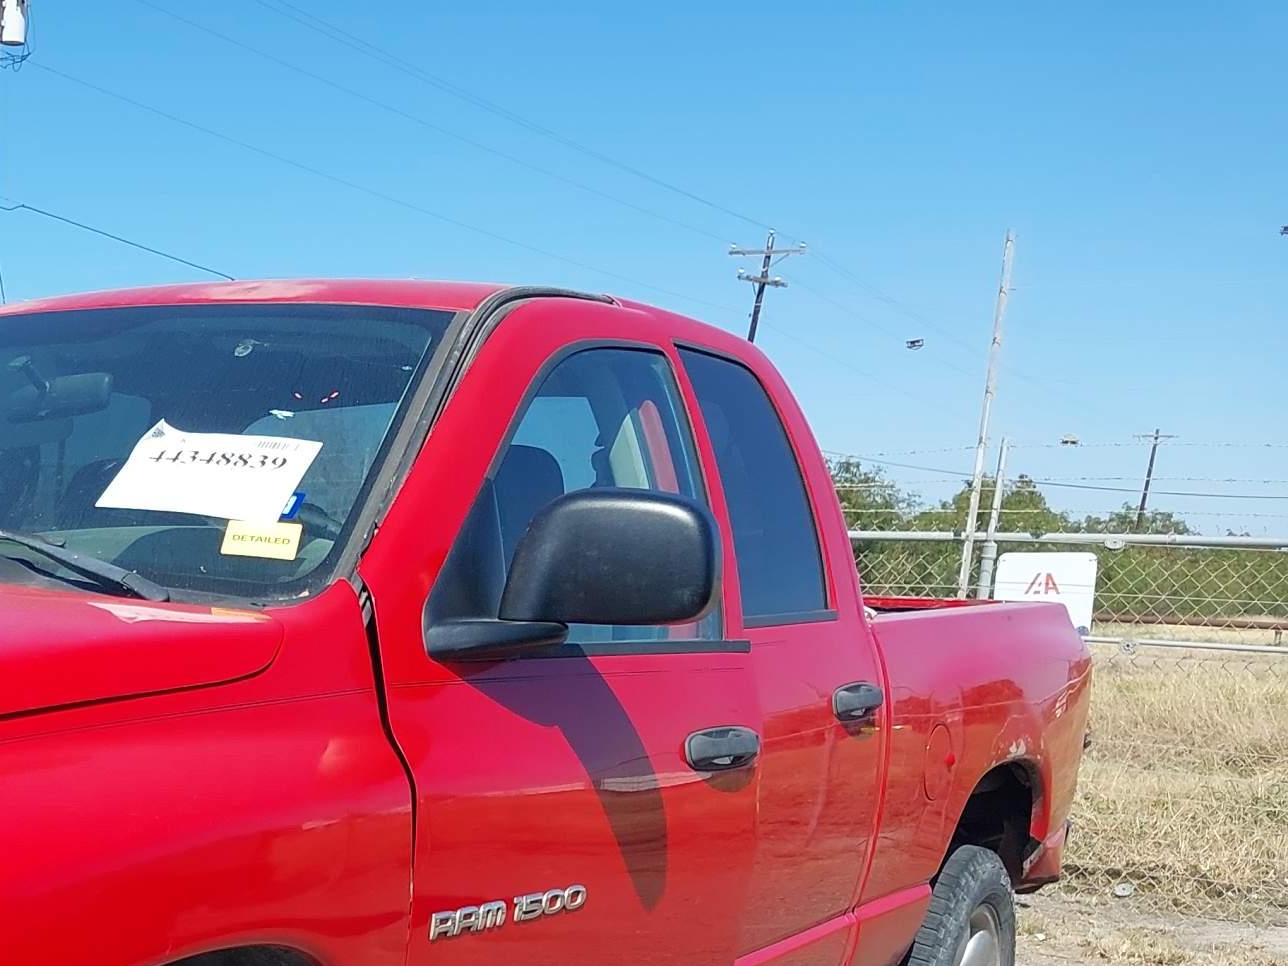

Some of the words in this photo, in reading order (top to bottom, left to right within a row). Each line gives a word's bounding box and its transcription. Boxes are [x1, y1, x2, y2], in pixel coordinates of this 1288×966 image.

[148, 449, 289, 471] 44348839
[231, 533, 292, 546] DETAILED
[429, 900, 508, 941] RAM
[513, 884, 587, 923] 1500
